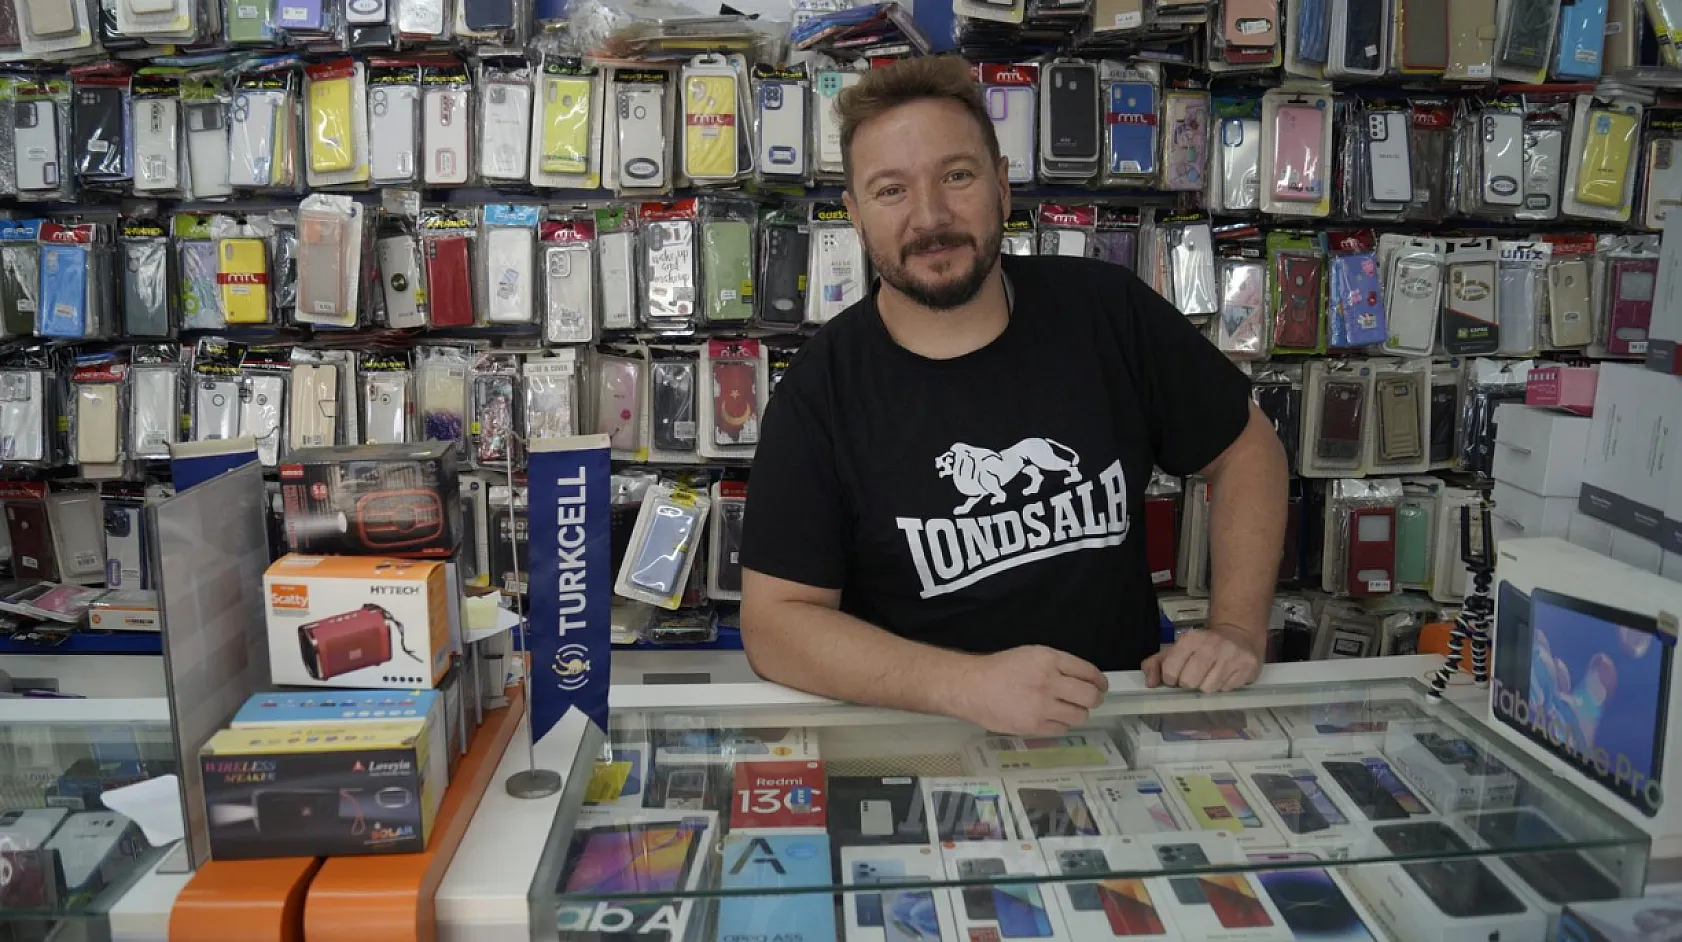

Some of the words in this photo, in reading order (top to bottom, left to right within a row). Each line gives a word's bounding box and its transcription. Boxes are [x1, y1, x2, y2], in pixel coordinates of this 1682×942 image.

[556, 466, 586, 636] TURKCELL
[370, 585, 419, 596] HYTECH
[1492, 677, 1528, 726] Tab
[1615, 751, 1664, 810] Pro
[205, 761, 276, 773] WIRELESS
[756, 777, 803, 786] Redmi
